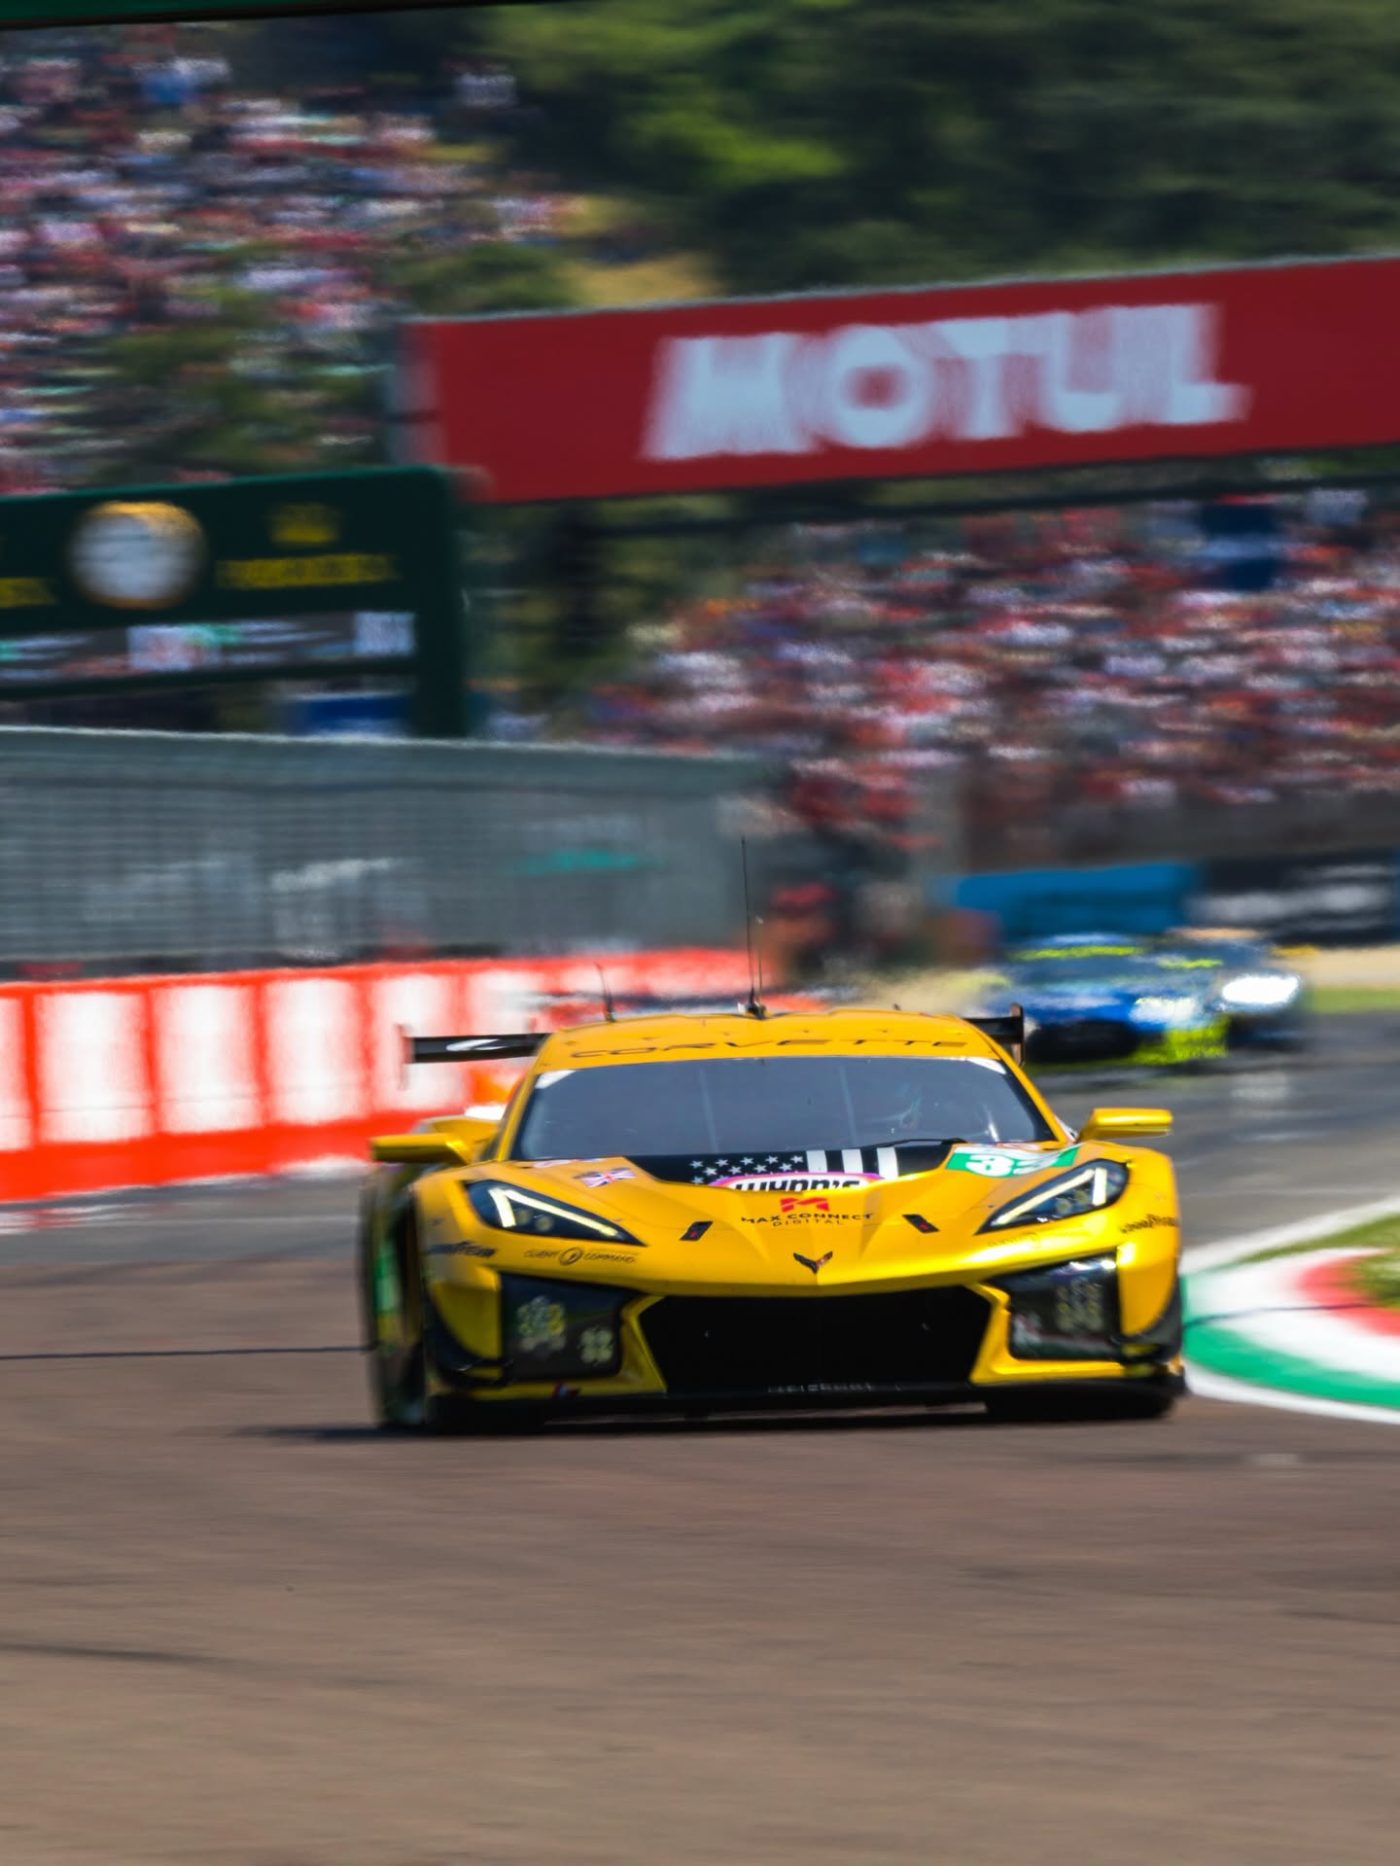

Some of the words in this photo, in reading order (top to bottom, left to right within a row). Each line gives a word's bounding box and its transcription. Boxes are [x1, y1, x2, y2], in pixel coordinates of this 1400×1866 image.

[638, 303, 1252, 462] MOTUL
[570, 1038, 969, 1058] CORVETTE
[740, 1213, 781, 1225] MAX
[786, 1212, 874, 1221] CONNECT
[772, 1218, 843, 1227] DIGITAL
